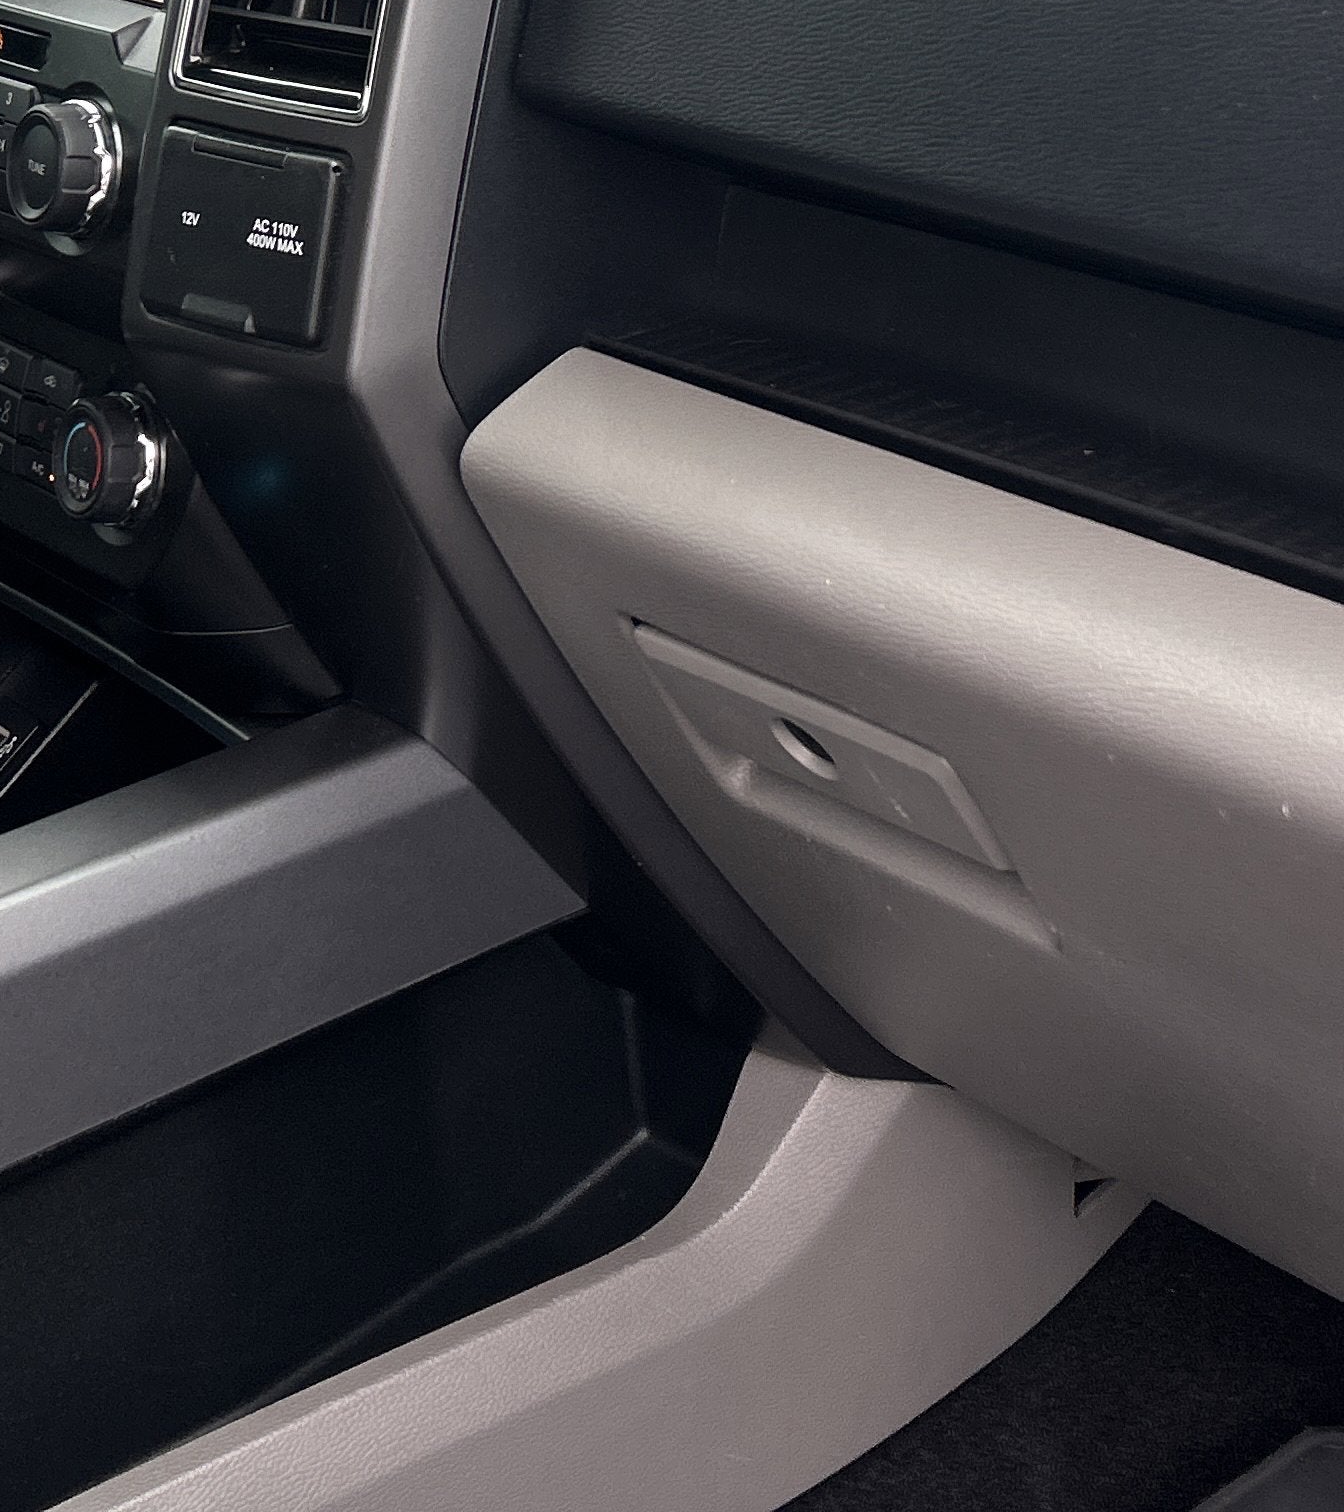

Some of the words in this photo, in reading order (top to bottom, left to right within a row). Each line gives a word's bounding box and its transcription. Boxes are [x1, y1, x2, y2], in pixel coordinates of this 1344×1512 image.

[5, 91, 14, 105] 3
[181, 211, 201, 226] 12V
[252, 218, 270, 233] AC
[271, 221, 299, 238] 110V
[246, 232, 277, 250] 400W
[276, 237, 305, 256] MAX
